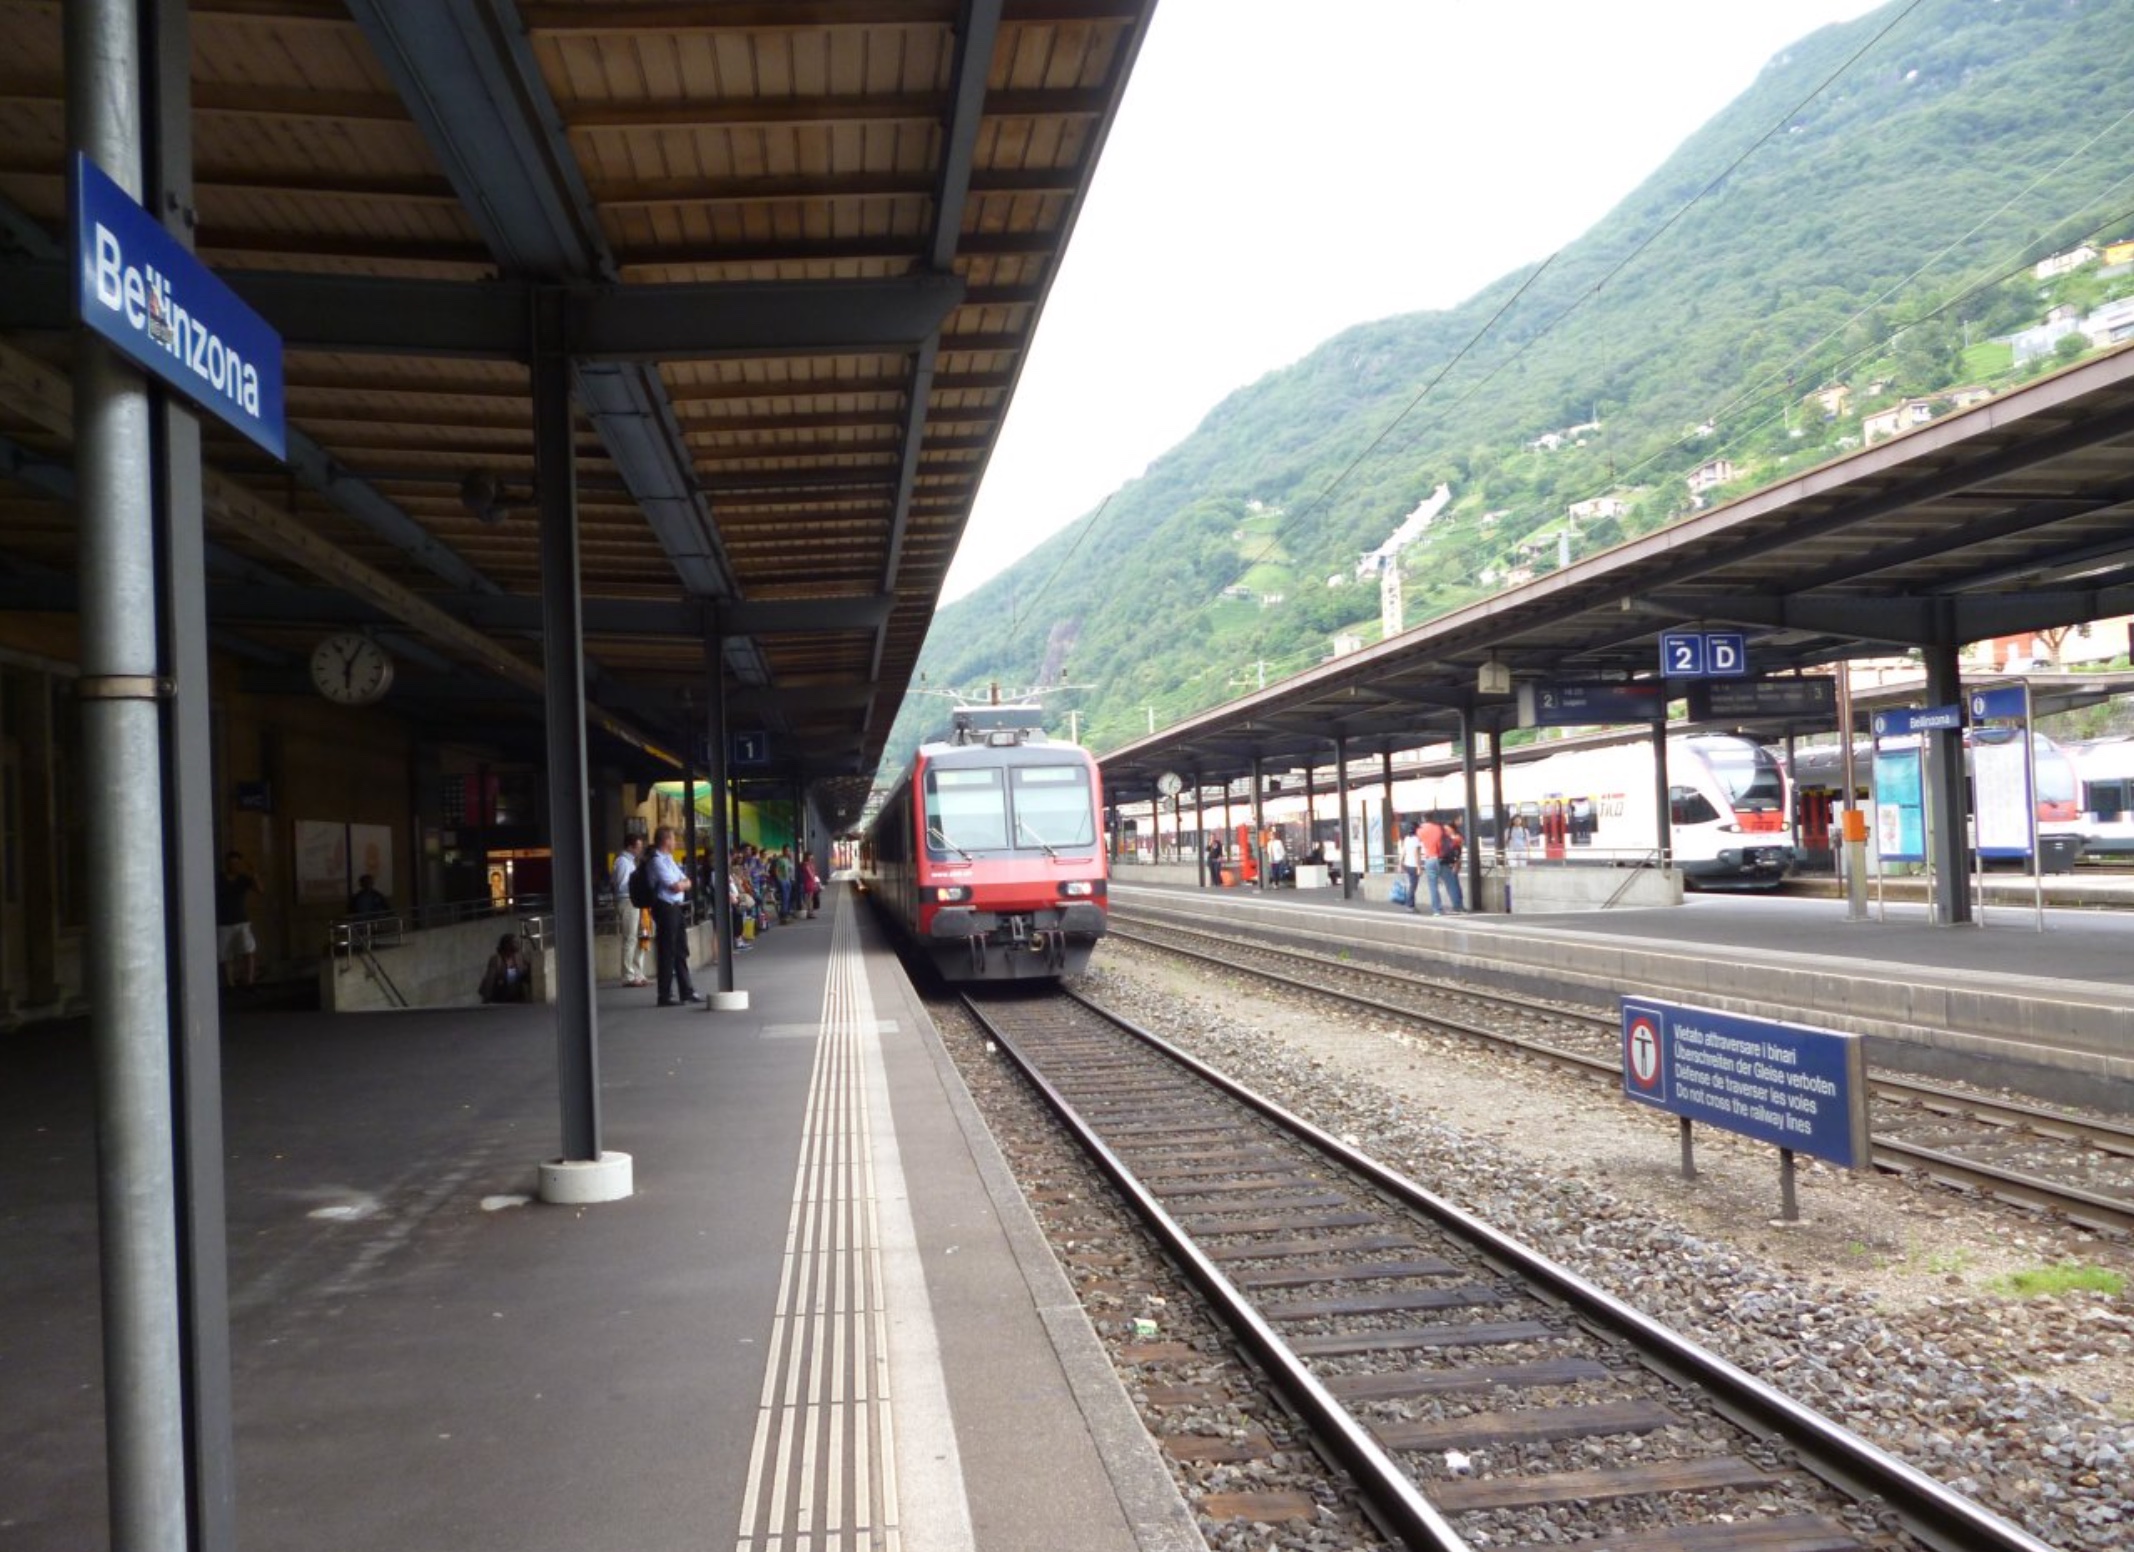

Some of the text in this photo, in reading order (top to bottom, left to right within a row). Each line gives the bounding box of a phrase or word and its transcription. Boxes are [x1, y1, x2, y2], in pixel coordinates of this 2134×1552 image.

[1676, 647, 1692, 669] 2
[1716, 646, 1735, 668] D
[1543, 694, 1552, 707] 2
[1910, 714, 1950, 729] Bellinzona
[746, 741, 754, 759] 1
[1673, 1023, 1796, 1065] Vietato attraversare i binari
[1736, 1058, 1752, 1076] der
[1753, 1061, 1785, 1085] Gleise
[1786, 1071, 1836, 1097] verboten
[1712, 1072, 1724, 1090] de
[1725, 1075, 1768, 1101] traverser
[1769, 1086, 1787, 1107] les
[1787, 1093, 1818, 1115] voies
[1676, 1082, 1812, 1135] Do not cross the railway lines
